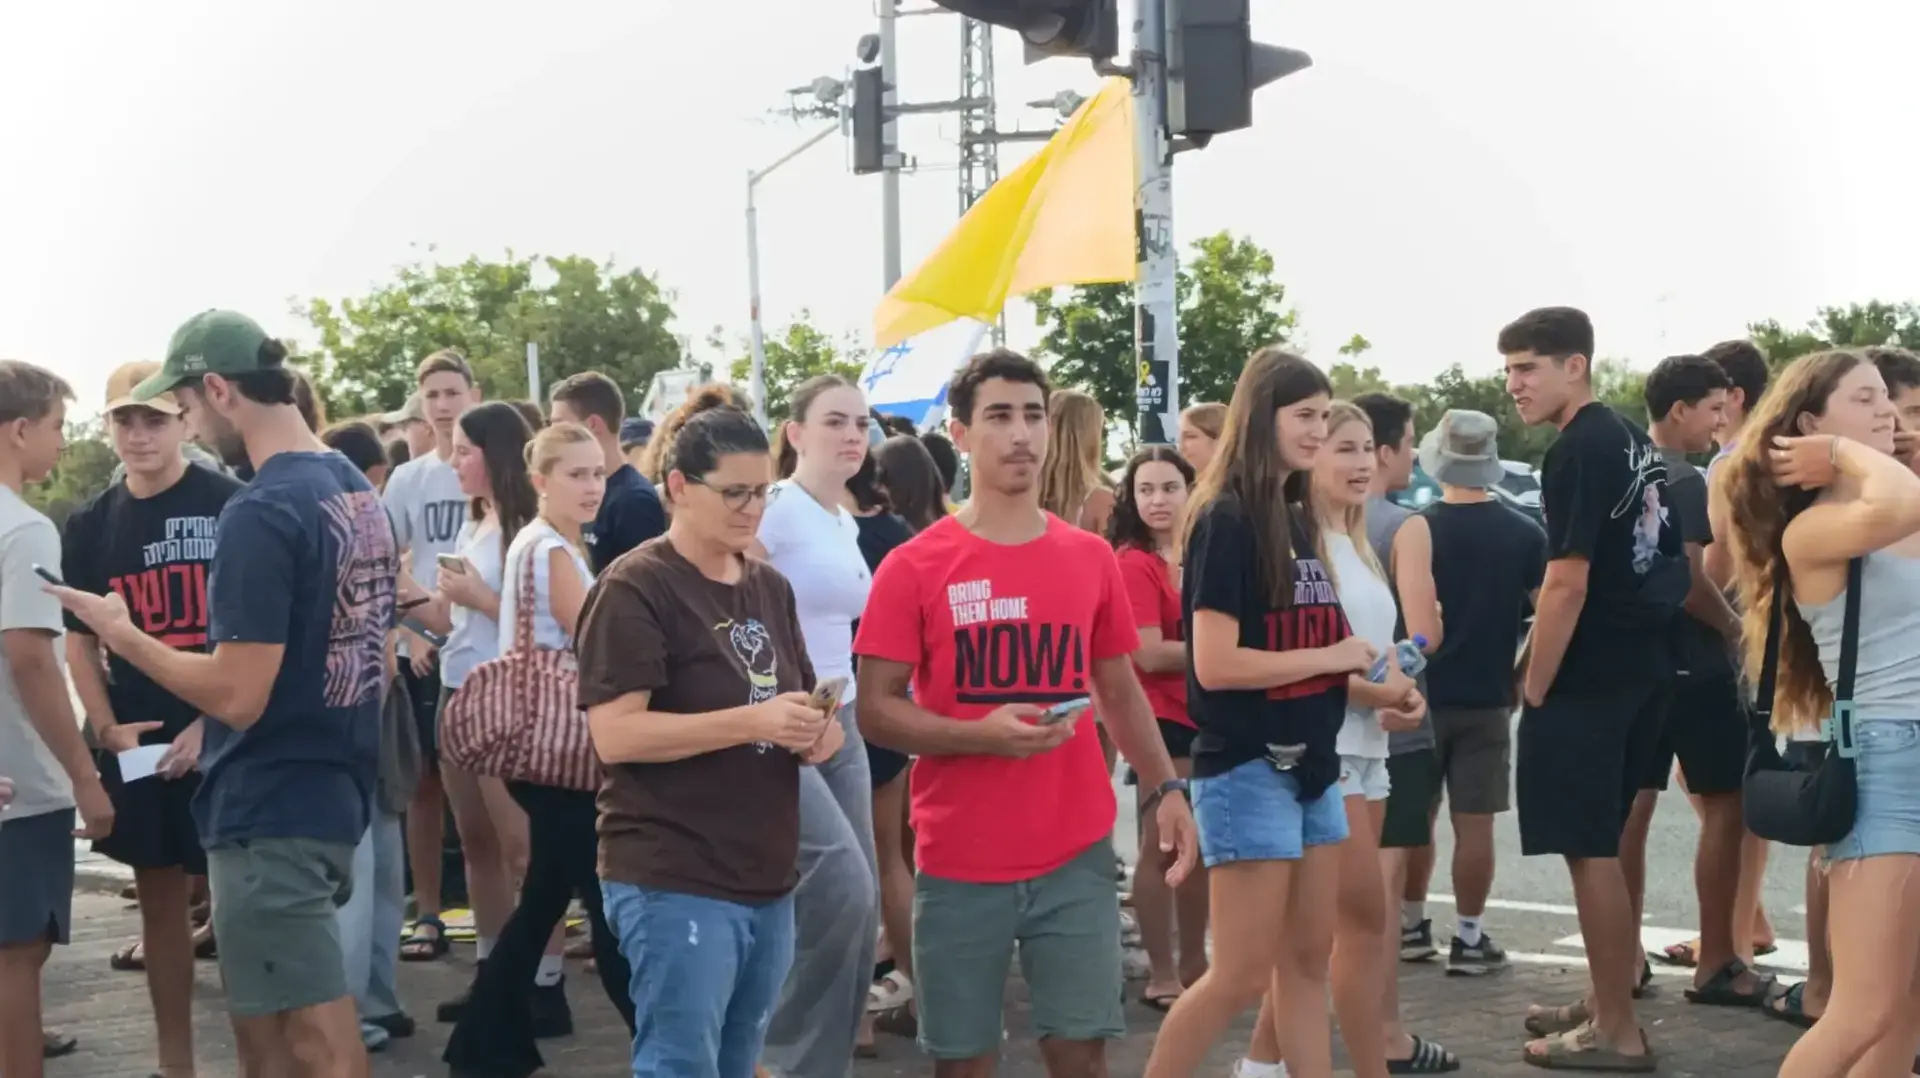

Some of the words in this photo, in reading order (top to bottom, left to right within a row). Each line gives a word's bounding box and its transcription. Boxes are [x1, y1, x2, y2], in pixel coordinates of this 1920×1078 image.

[947, 579, 992, 606] BRING
[952, 600, 988, 627] THEM
[990, 597, 1028, 620] HOME
[954, 623, 1084, 688] NOW!
